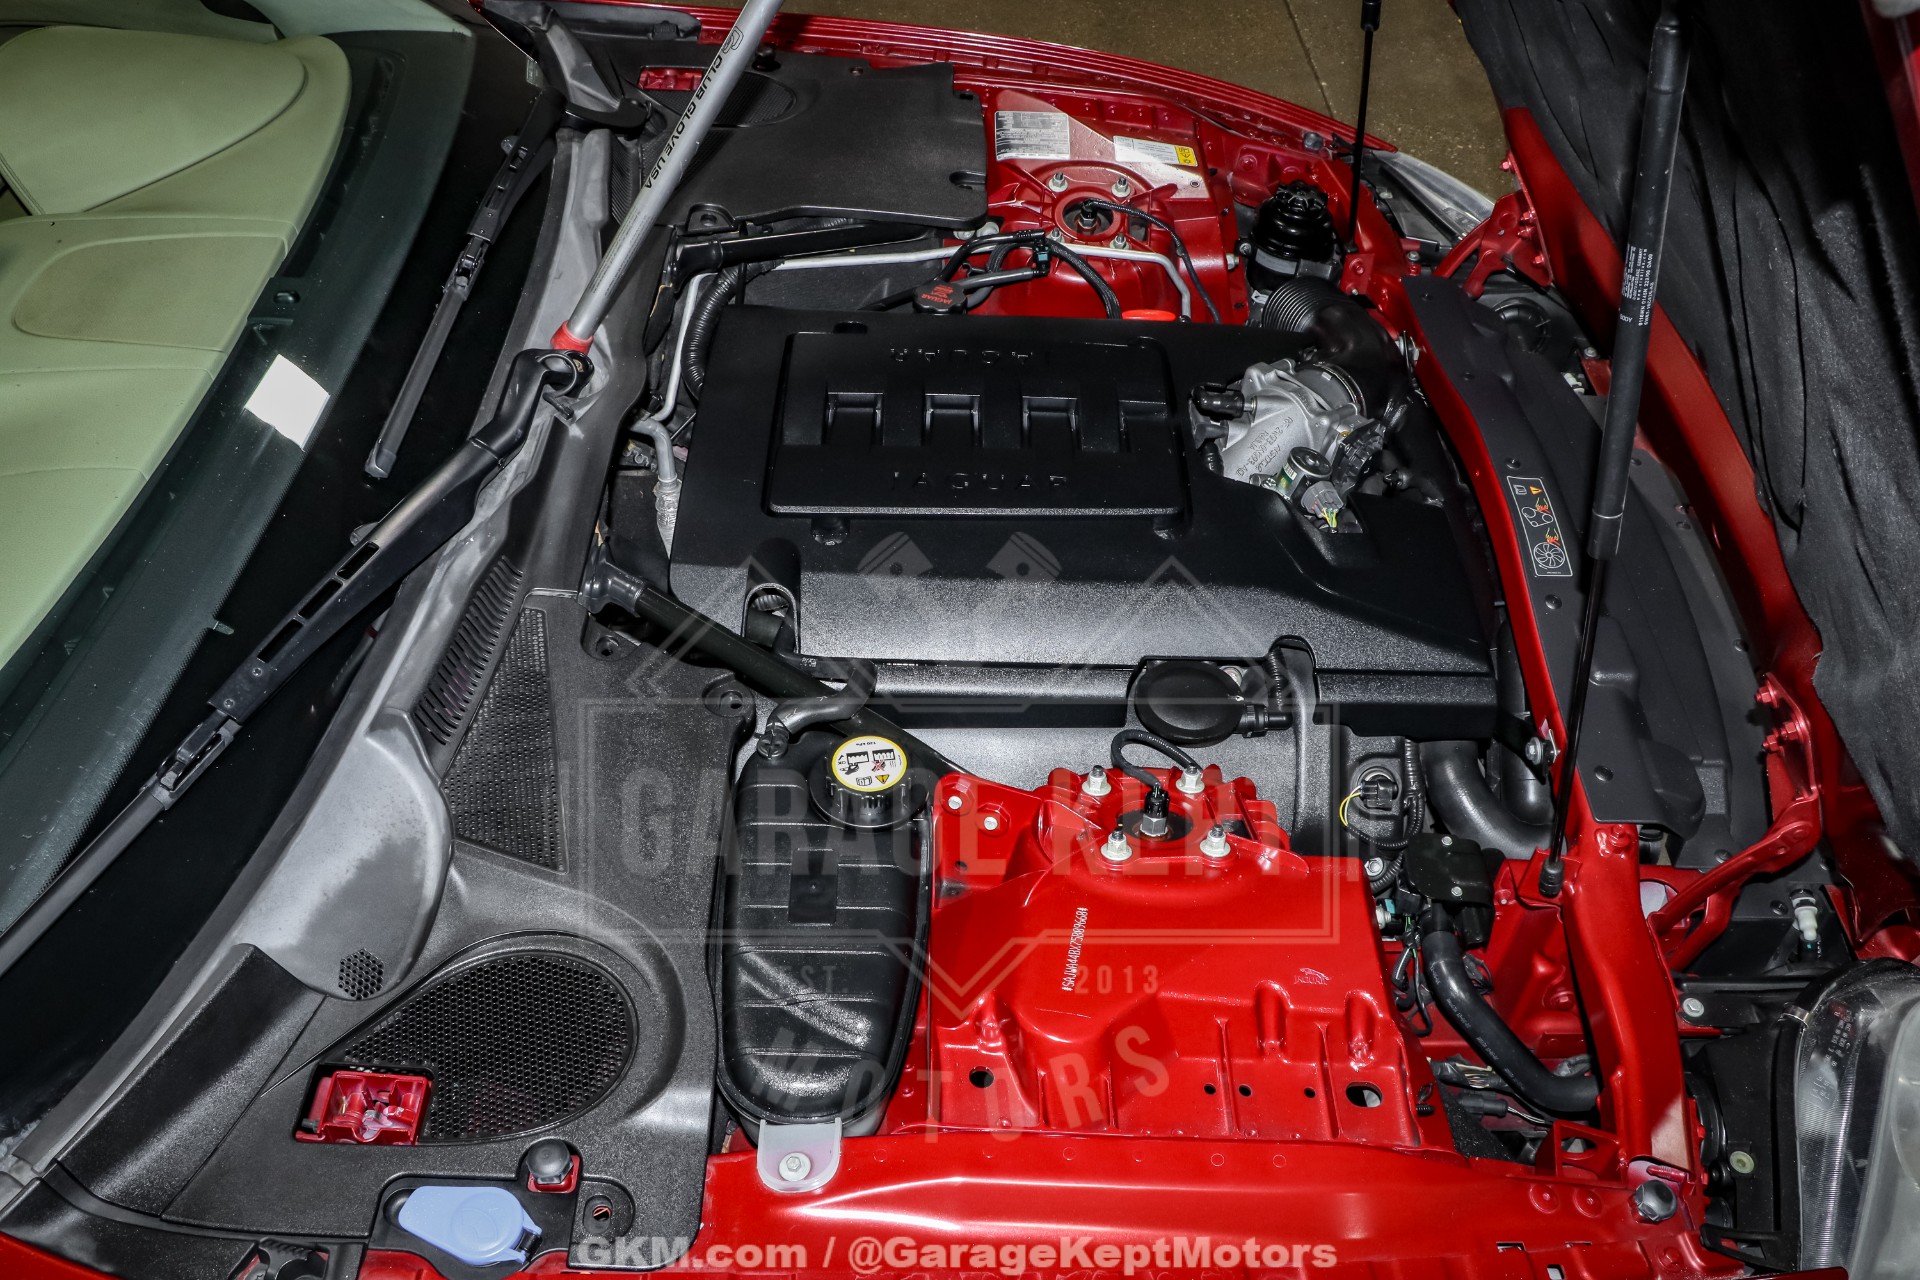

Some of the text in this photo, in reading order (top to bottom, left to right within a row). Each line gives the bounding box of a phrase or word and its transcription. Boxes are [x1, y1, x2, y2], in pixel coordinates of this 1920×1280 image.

[643, 54, 724, 190] CLUB GLOVE USA
[921, 293, 953, 305] JAGUAR
